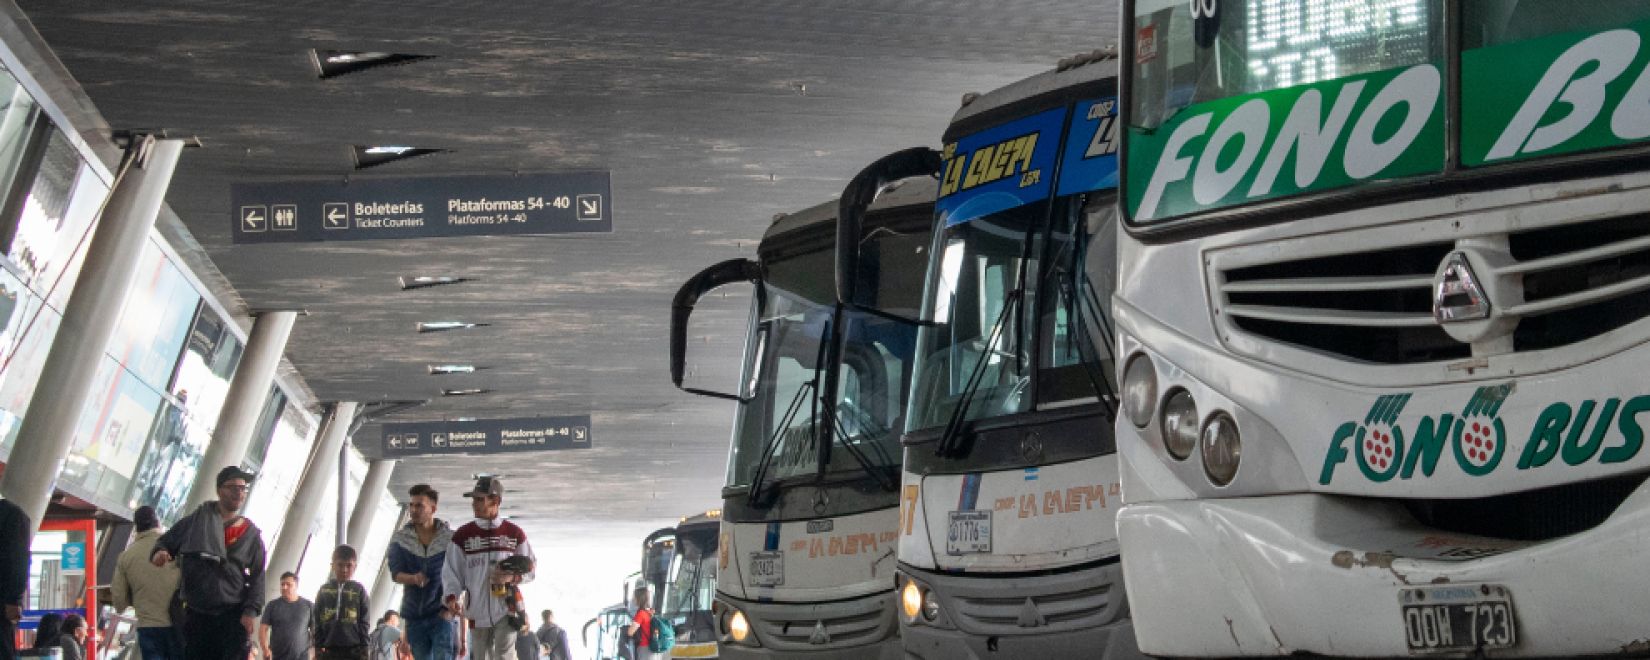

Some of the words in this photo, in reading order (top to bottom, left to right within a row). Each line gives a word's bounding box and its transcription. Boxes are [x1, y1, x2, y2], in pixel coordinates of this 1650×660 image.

[1134, 64, 1441, 221] FONO
[940, 155, 967, 198] LA
[354, 201, 424, 215] Boleterías
[448, 198, 525, 212] Plataformas
[527, 197, 544, 210] 54
[553, 197, 570, 209] 40
[354, 218, 382, 228] Ticket
[384, 217, 424, 228] Counters
[448, 214, 494, 225] Platforms
[1318, 388, 1507, 485] FONO
[1517, 394, 1650, 470] BUS
[1019, 494, 1038, 518] LA
[809, 538, 825, 558] LA
[1406, 606, 1454, 647] OOW
[1465, 603, 1508, 645] 723
